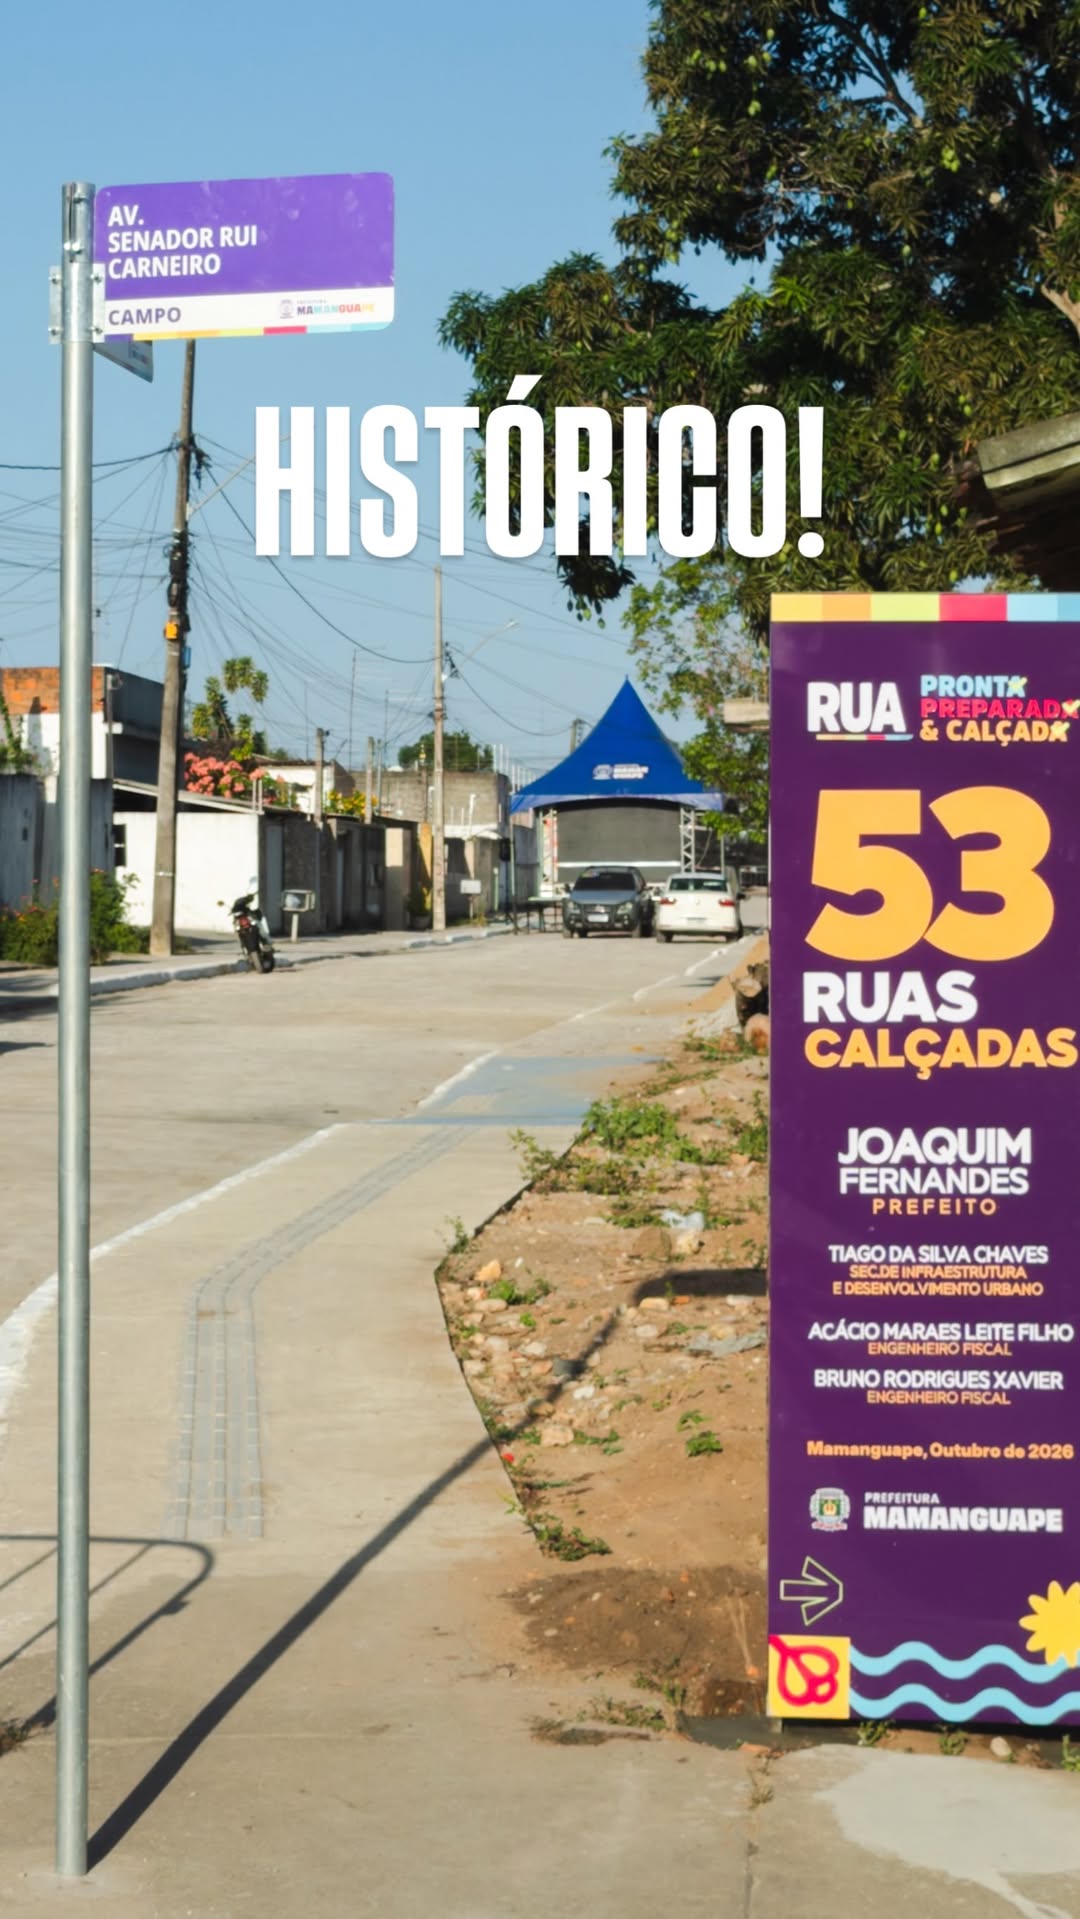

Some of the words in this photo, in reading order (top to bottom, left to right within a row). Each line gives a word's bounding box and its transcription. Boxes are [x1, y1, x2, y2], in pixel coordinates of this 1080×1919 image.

[108, 205, 145, 226] AV.
[108, 228, 214, 252] SENADOR
[219, 225, 257, 247] RUI
[108, 253, 221, 279] CARNEIRO
[108, 306, 182, 326] CAMPO
[296, 303, 375, 315] MAMANGUAPE
[920, 674, 1026, 698] PRONTA
[807, 682, 907, 732] RUA
[919, 720, 939, 741] &
[946, 720, 1069, 747] CALÇADA
[805, 785, 1055, 962] 53
[803, 970, 979, 1024] RUAS
[804, 1028, 1079, 1080] CALÇADAS
[837, 1127, 1032, 1165] JOAQUIM
[839, 1167, 1030, 1195] FERNANDES
[872, 1198, 997, 1216] PREFEITO
[828, 1244, 886, 1263] TIAGO
[889, 1245, 916, 1263] DA
[918, 1245, 971, 1263] SILVA
[973, 1245, 1049, 1264] CHAVES
[902, 1264, 1028, 1280] INFRAESTRUTURA
[832, 1281, 842, 1296] E
[844, 1281, 981, 1297] DESENVOLVIMENTO
[983, 1281, 1044, 1297] URBANO
[808, 1319, 881, 1341] ACÁCIO
[883, 1322, 962, 1341] MARAES
[964, 1322, 1015, 1342] LEITE
[1017, 1323, 1075, 1343] FILHO
[867, 1341, 960, 1356] ENGENHEIRO
[962, 1342, 1012, 1357] FISCAL
[813, 1368, 881, 1389] BRUNO
[883, 1369, 991, 1390] RODRIGUES
[992, 1371, 1065, 1391] XAVIER
[866, 1389, 959, 1405] ENGENHEIRO
[960, 1391, 1012, 1406] FISCAL
[807, 1440, 928, 1461] Mamanguape,
[929, 1442, 1001, 1458] Outubro
[1003, 1444, 1026, 1459] de
[1028, 1444, 1075, 1460] 2026
[864, 1491, 941, 1505] PREFEITURA
[863, 1506, 1064, 1533] MAMANGUAPE
